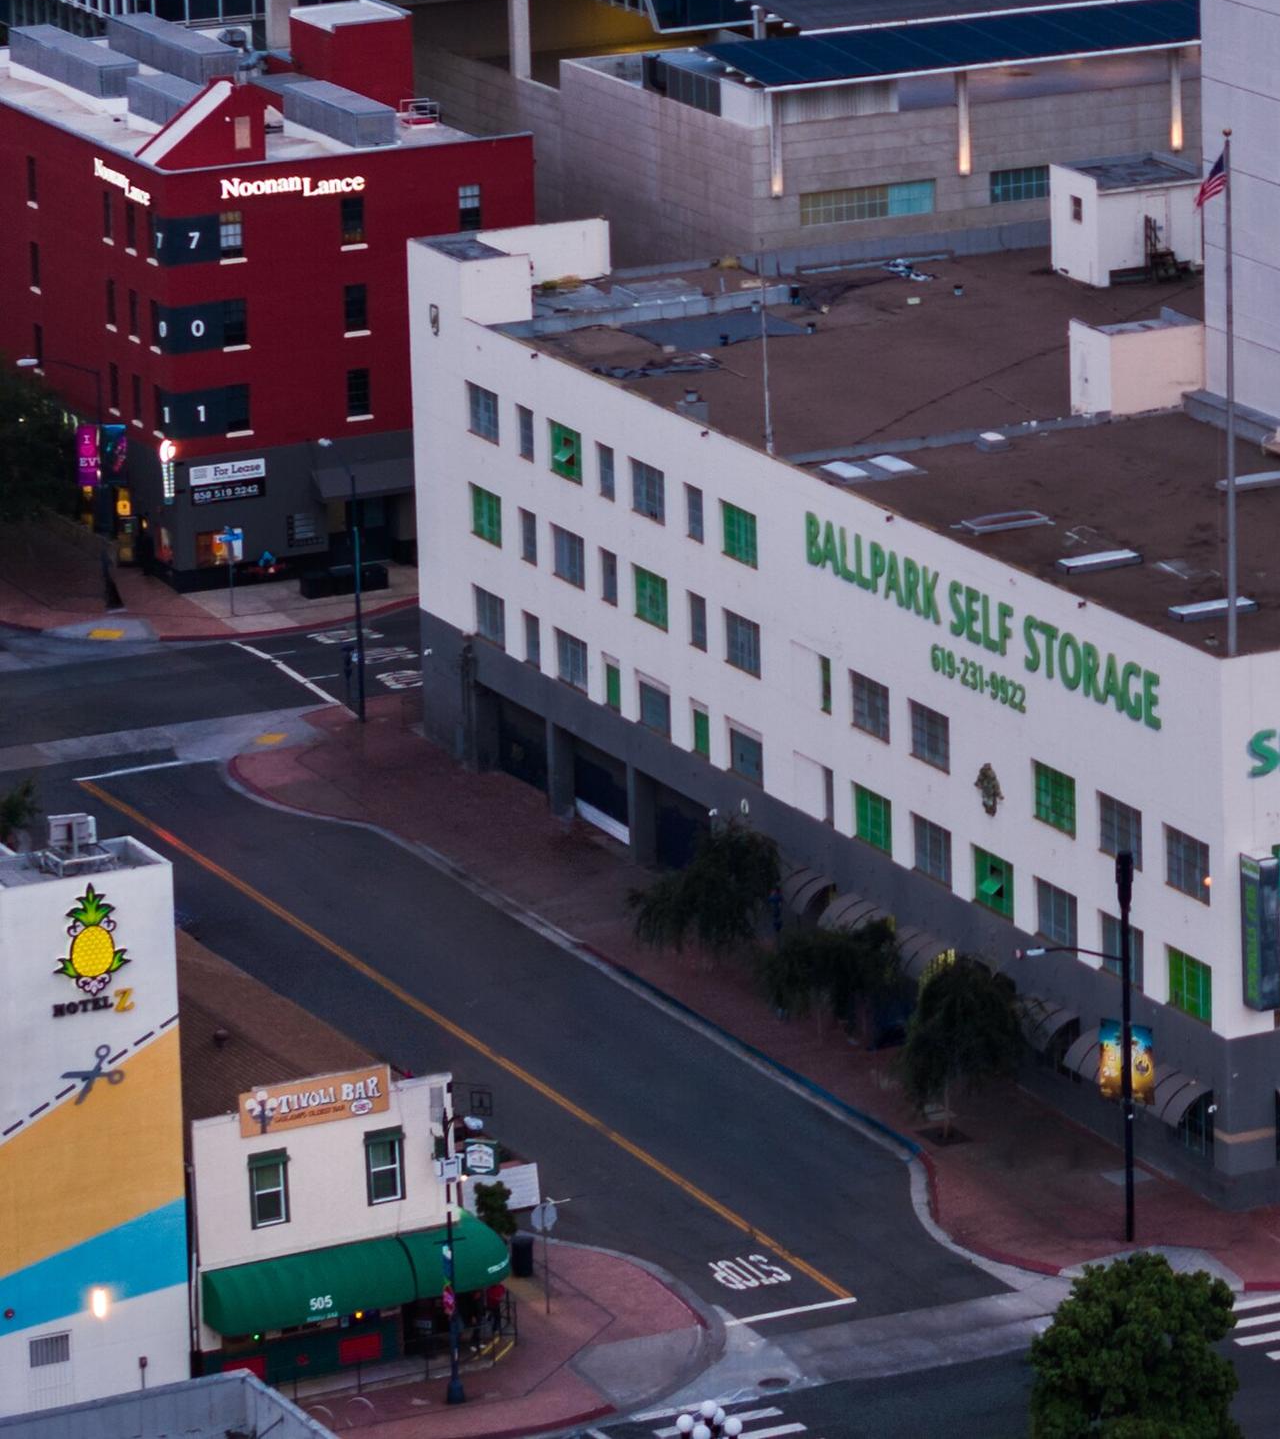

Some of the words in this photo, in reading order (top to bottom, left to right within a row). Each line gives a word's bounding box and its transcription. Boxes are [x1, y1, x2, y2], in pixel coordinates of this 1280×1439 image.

[220, 176, 302, 199] Noonan
[302, 176, 365, 197] Lance
[188, 232, 200, 249] 7
[191, 320, 205, 337] 0
[197, 405, 205, 422] 1
[214, 466, 228, 476] For
[231, 463, 260, 474] Lease
[805, 511, 941, 624] BALLPARK
[949, 580, 1013, 657] SELF
[1023, 615, 1162, 731] STORAGE
[930, 643, 1026, 714] 619-231-9922
[52, 996, 114, 1018] HOTEL
[114, 987, 136, 1013] Z
[278, 1087, 336, 1114] TIVOLI
[341, 1076, 382, 1101] BAR
[309, 1294, 333, 1311] 505
